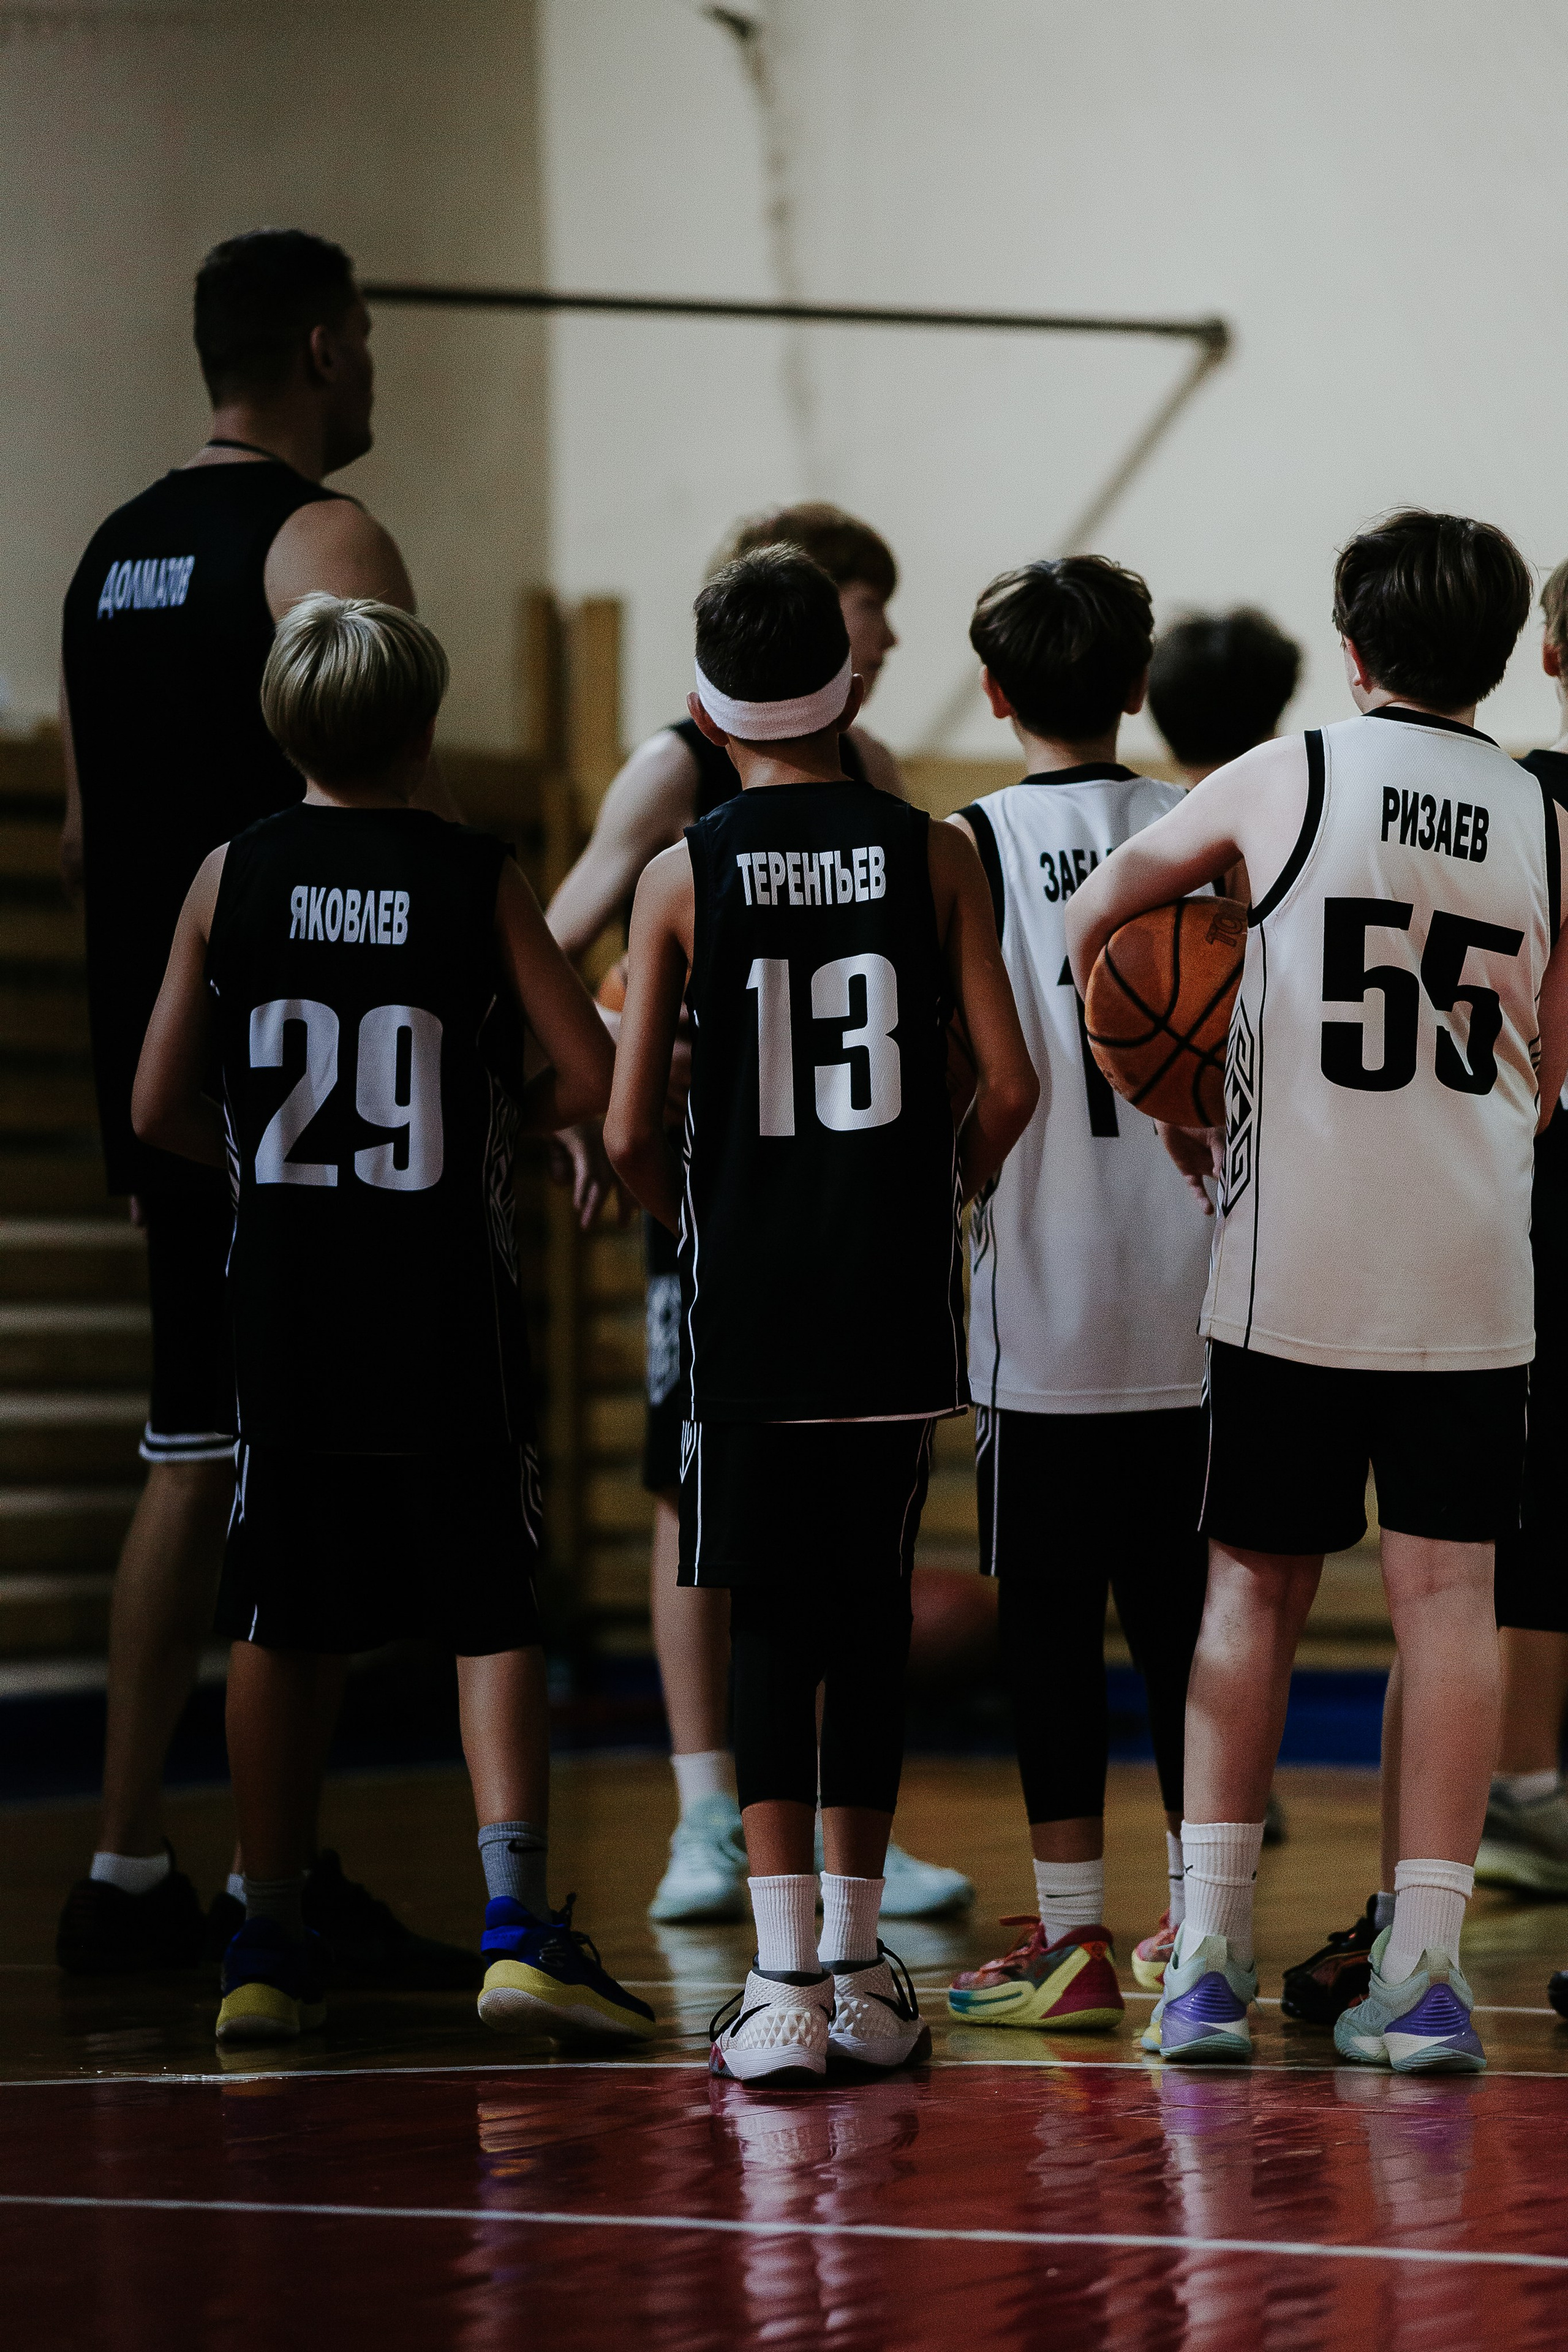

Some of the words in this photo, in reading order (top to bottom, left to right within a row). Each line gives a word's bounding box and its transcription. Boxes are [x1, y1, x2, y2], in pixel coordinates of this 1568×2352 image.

[736, 846, 886, 905] ТЕРЕНТЬЕВ
[1040, 848, 1113, 903] ЗАБ
[1381, 786, 1489, 863] РИЗАЕВ
[290, 886, 410, 944] ЯКОВЛЕВ
[746, 953, 901, 1136] 13
[1057, 956, 1158, 1137] 1
[1321, 897, 1525, 1095] 55
[249, 999, 443, 1191] 29
